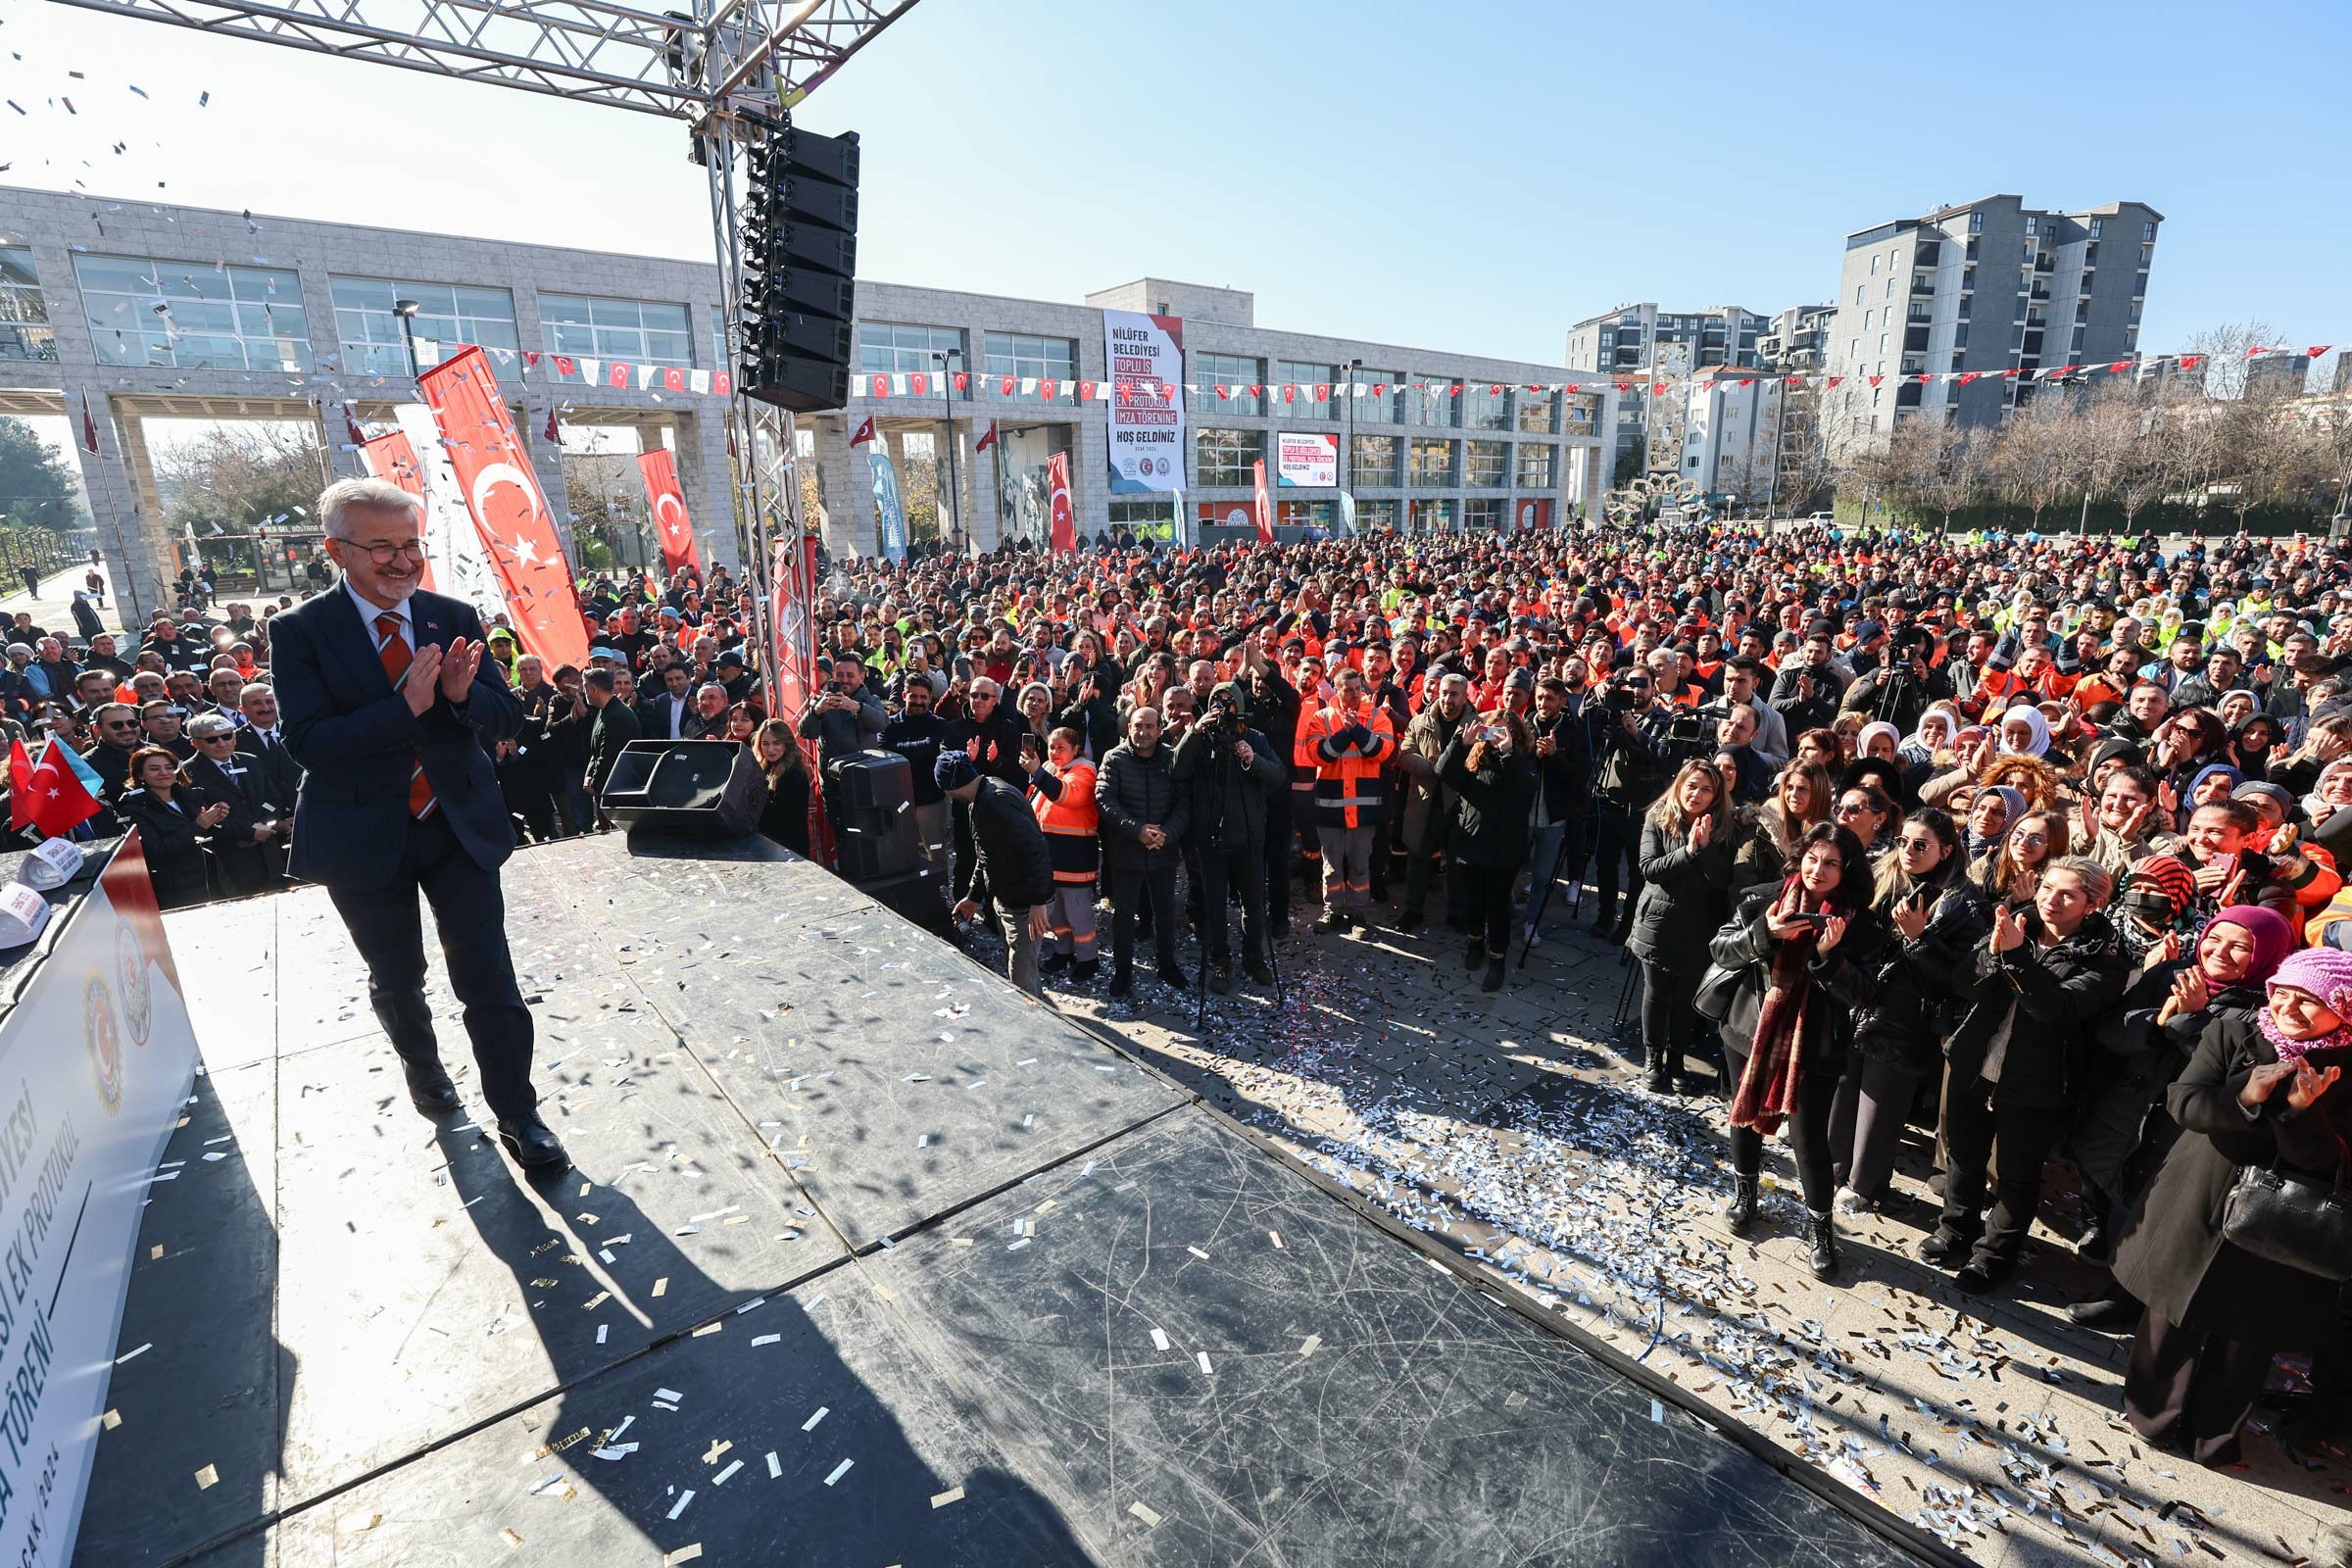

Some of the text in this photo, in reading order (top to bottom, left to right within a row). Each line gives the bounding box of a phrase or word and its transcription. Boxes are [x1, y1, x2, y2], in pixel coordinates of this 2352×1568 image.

[1113, 326, 1149, 342] NİLÜFER
[1113, 343, 1160, 358] BELEDİYESİ
[1115, 359, 1152, 374] TOPLU İŞ
[1128, 395, 1168, 408] PROTOKOL
[1116, 409, 1176, 425] İMZA TÖRENİNE
[1116, 429, 1176, 446] HOŞ GELDİNİZ
[253, 525, 277, 534] DOALA
[6, 1228, 32, 1305] EK
[24, 1110, 79, 1261] PROTOKOL
[0, 1298, 54, 1469] TÖRENİ
